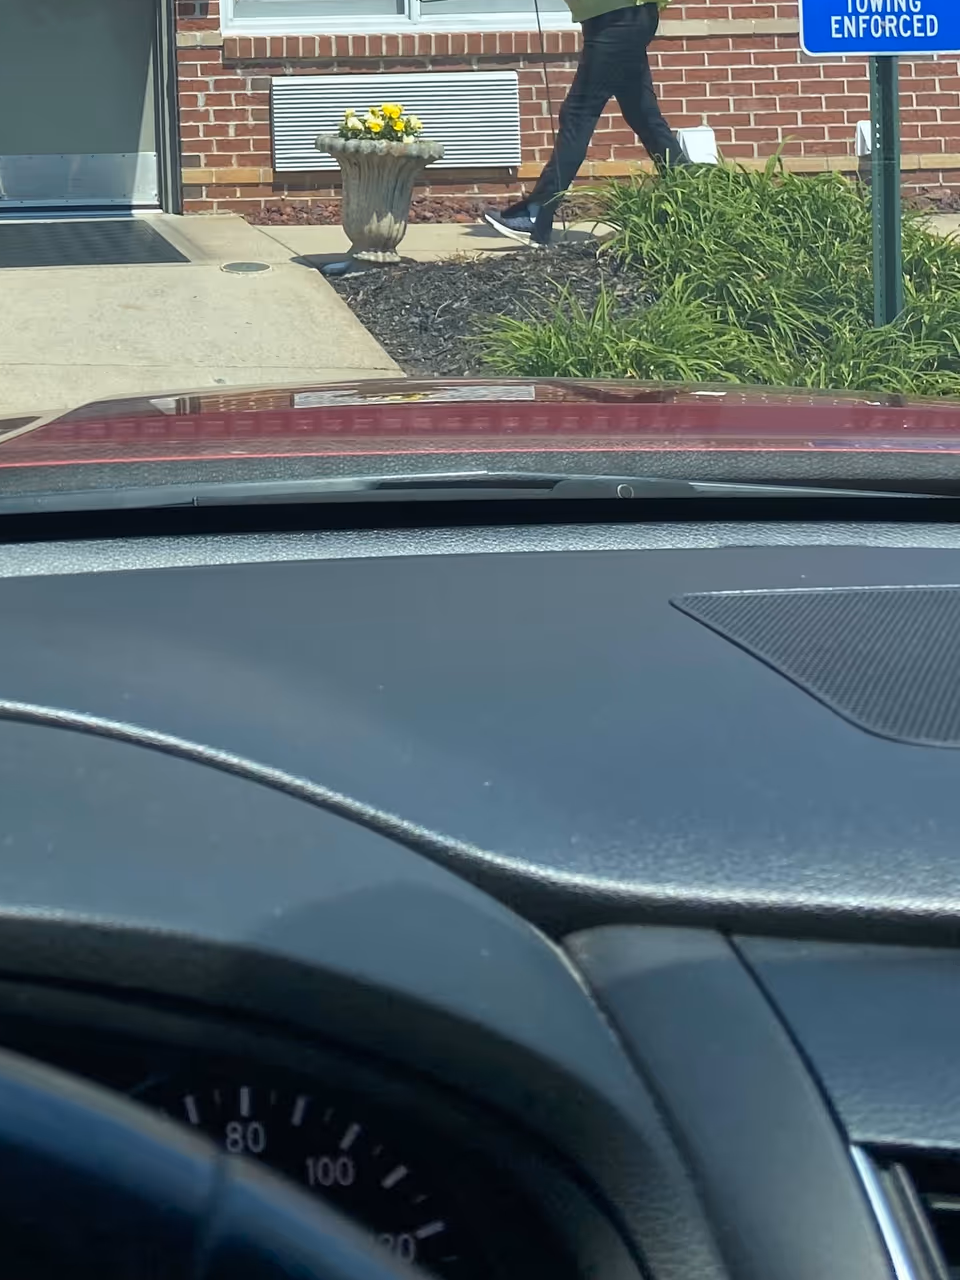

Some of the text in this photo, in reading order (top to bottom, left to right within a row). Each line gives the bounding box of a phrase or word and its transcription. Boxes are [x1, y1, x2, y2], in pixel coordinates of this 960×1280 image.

[830, 14, 939, 38] ENFORCED
[225, 1121, 266, 1153] 80
[305, 1156, 355, 1186] 100
